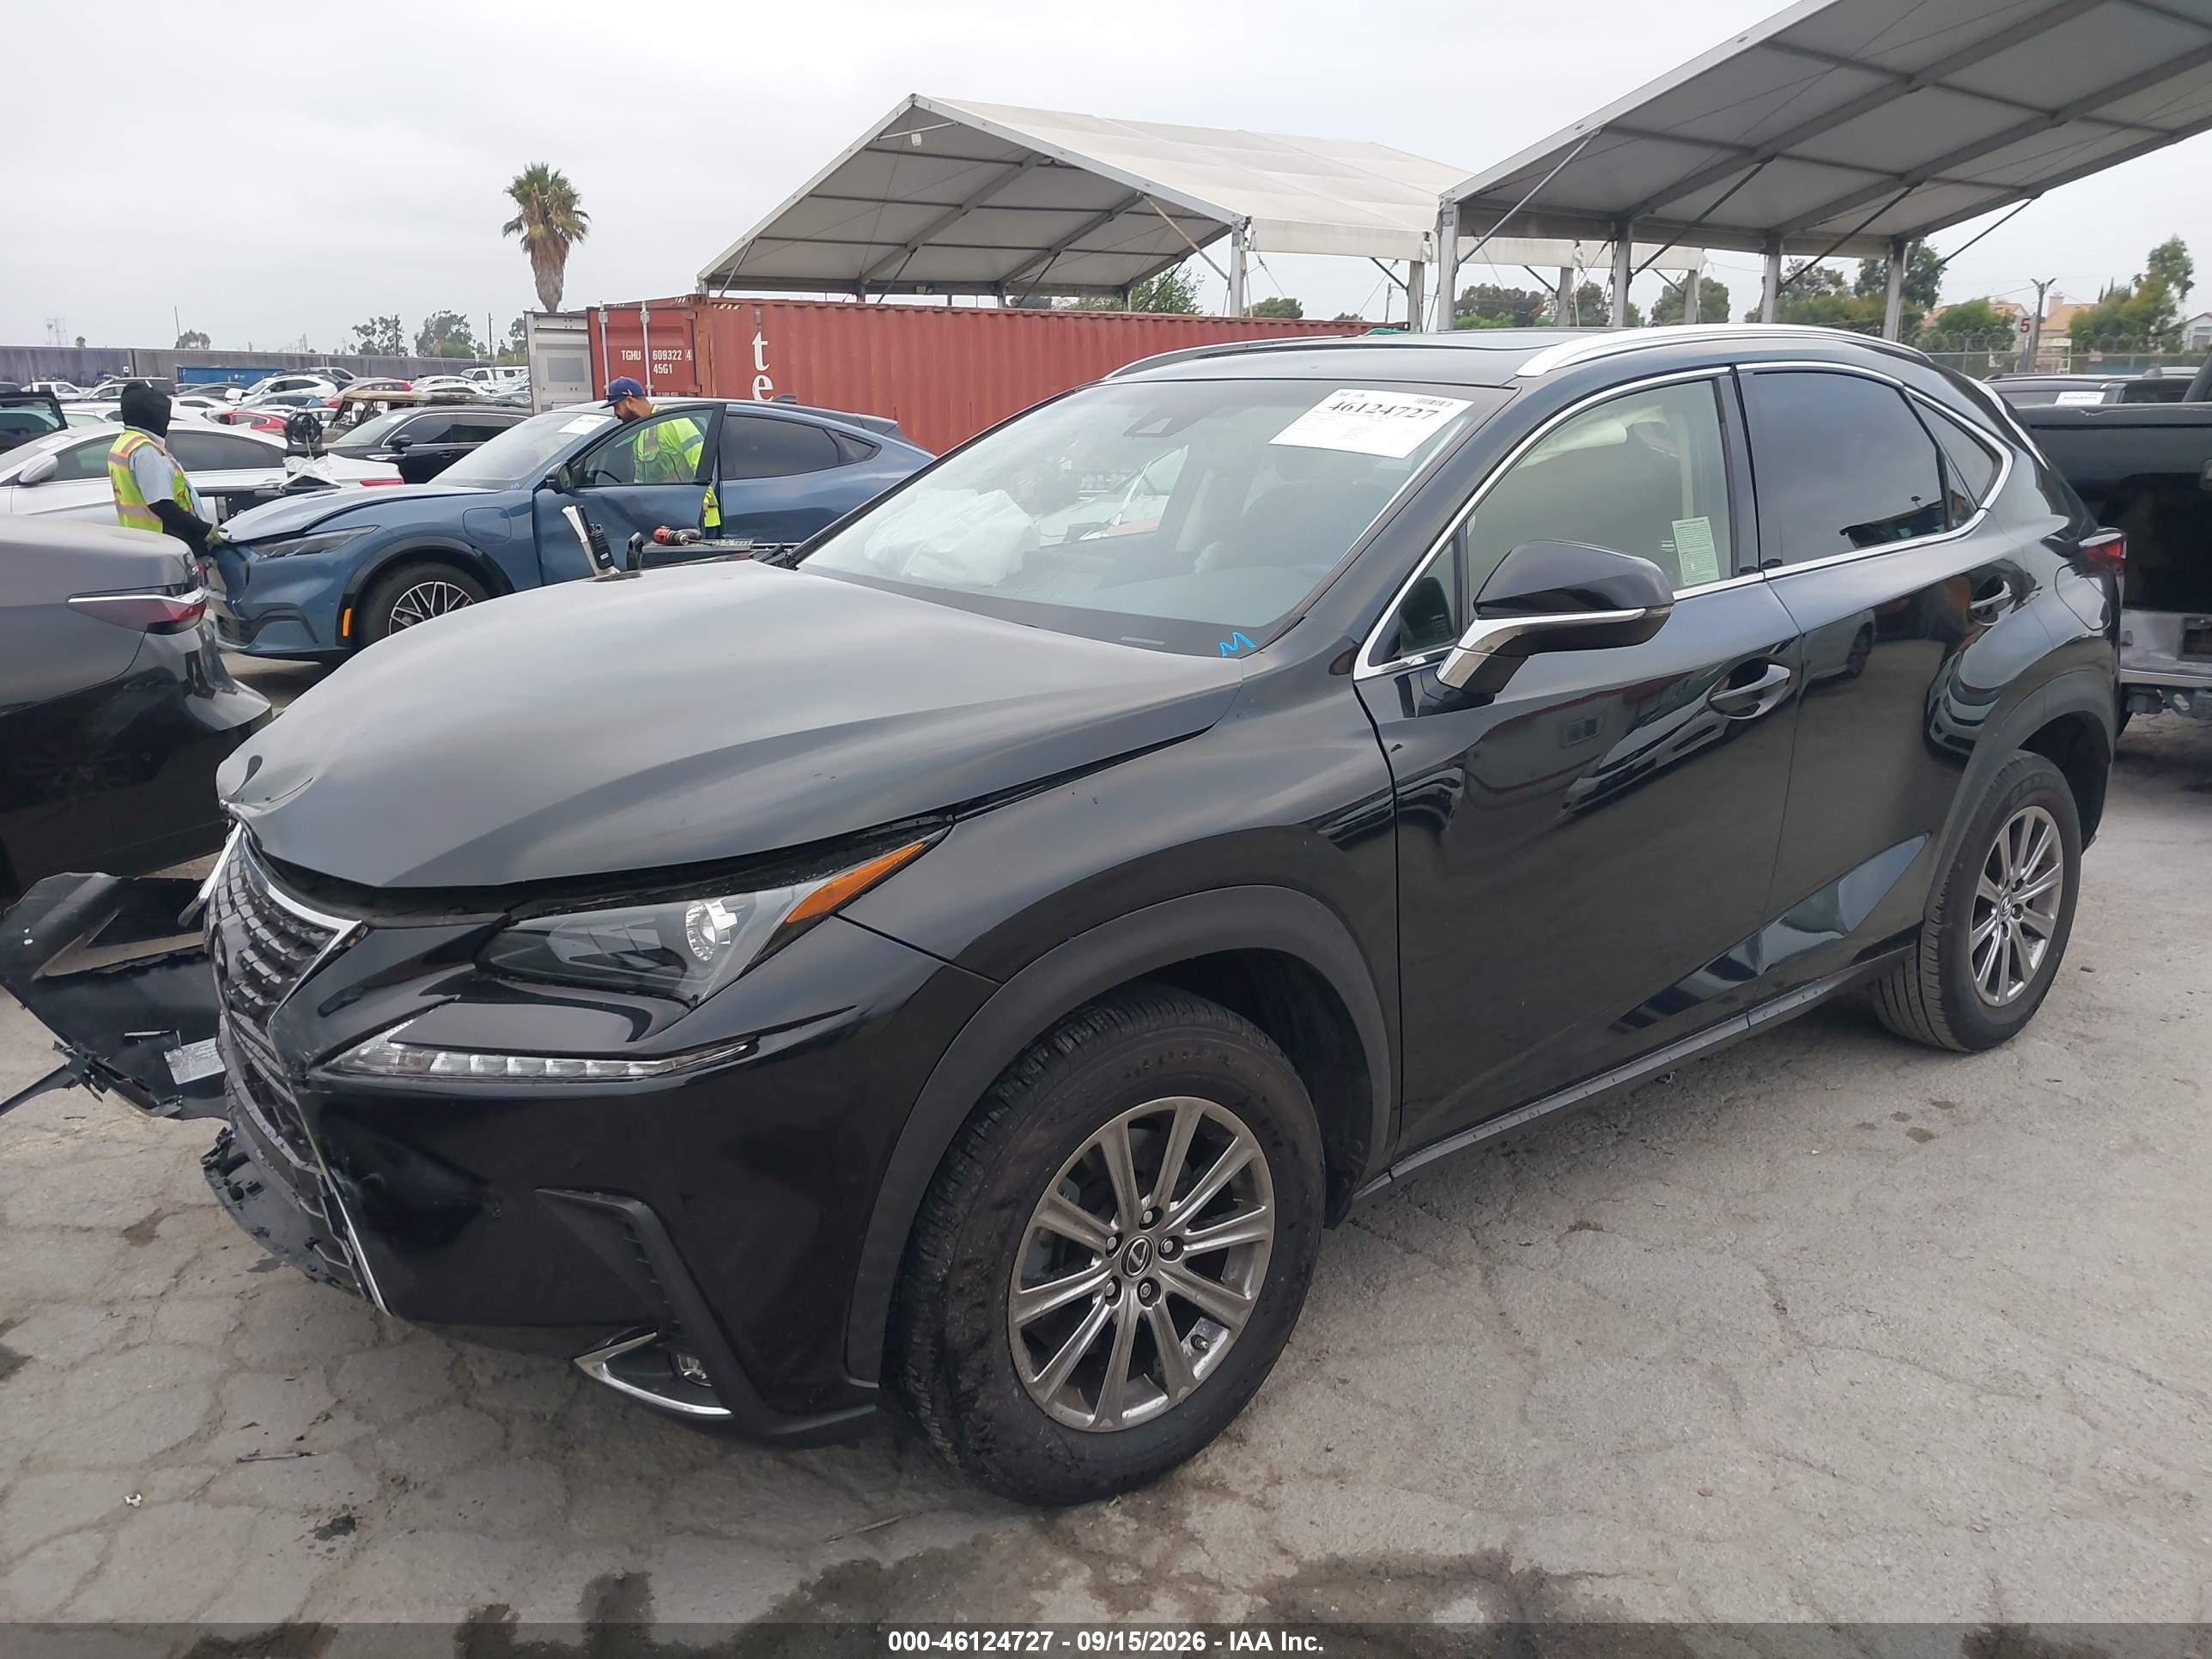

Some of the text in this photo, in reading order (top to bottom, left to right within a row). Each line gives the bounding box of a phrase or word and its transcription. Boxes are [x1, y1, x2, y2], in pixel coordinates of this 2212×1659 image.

[2020, 318, 2031, 333] 5
[620, 349, 641, 362] TGHU
[652, 349, 682, 362] 609322
[653, 363, 673, 374] 45G1
[1327, 400, 1441, 420] 46124727
[1218, 631, 1256, 657] M
